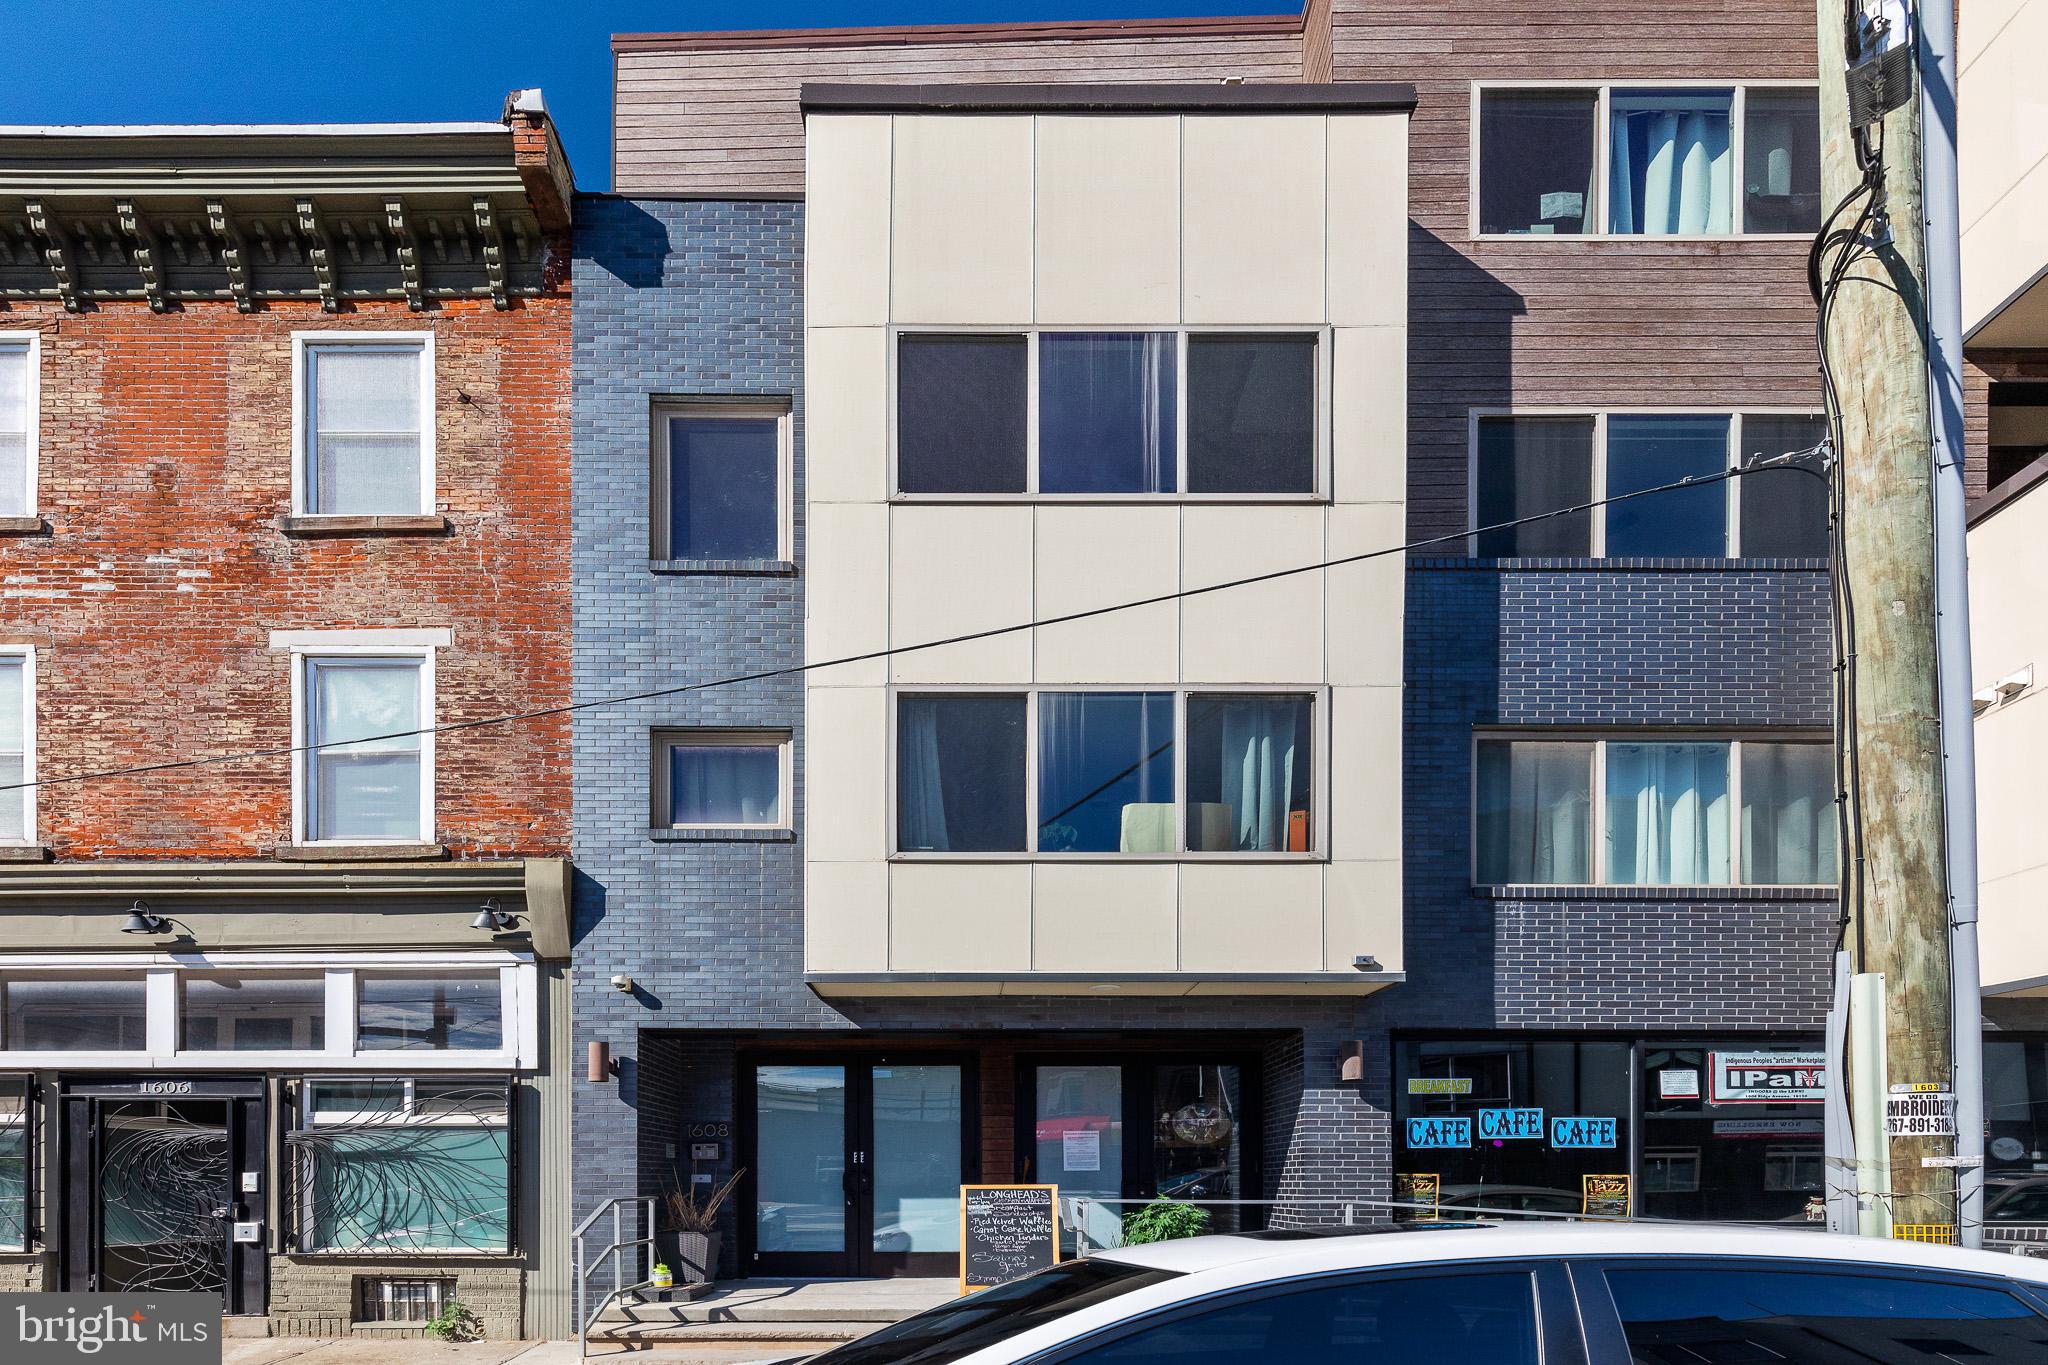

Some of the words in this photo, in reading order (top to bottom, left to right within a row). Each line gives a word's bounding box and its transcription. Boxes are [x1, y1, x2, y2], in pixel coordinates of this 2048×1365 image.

[1725, 1057, 1751, 1065] Indigenous
[1753, 1057, 1772, 1065] Peoples
[1797, 1057, 1825, 1065] Marketplac
[142, 1081, 189, 1094] 1606
[1410, 1079, 1471, 1093] BREAKFAST
[1915, 1083, 1939, 1091] 1603
[688, 1123, 729, 1137] 1608
[1481, 1111, 1541, 1136] CAFE
[1409, 1120, 1469, 1146] CAFE
[1554, 1119, 1615, 1145] CAFE
[973, 1217, 991, 1226] Red
[992, 1217, 1017, 1225] Velvet
